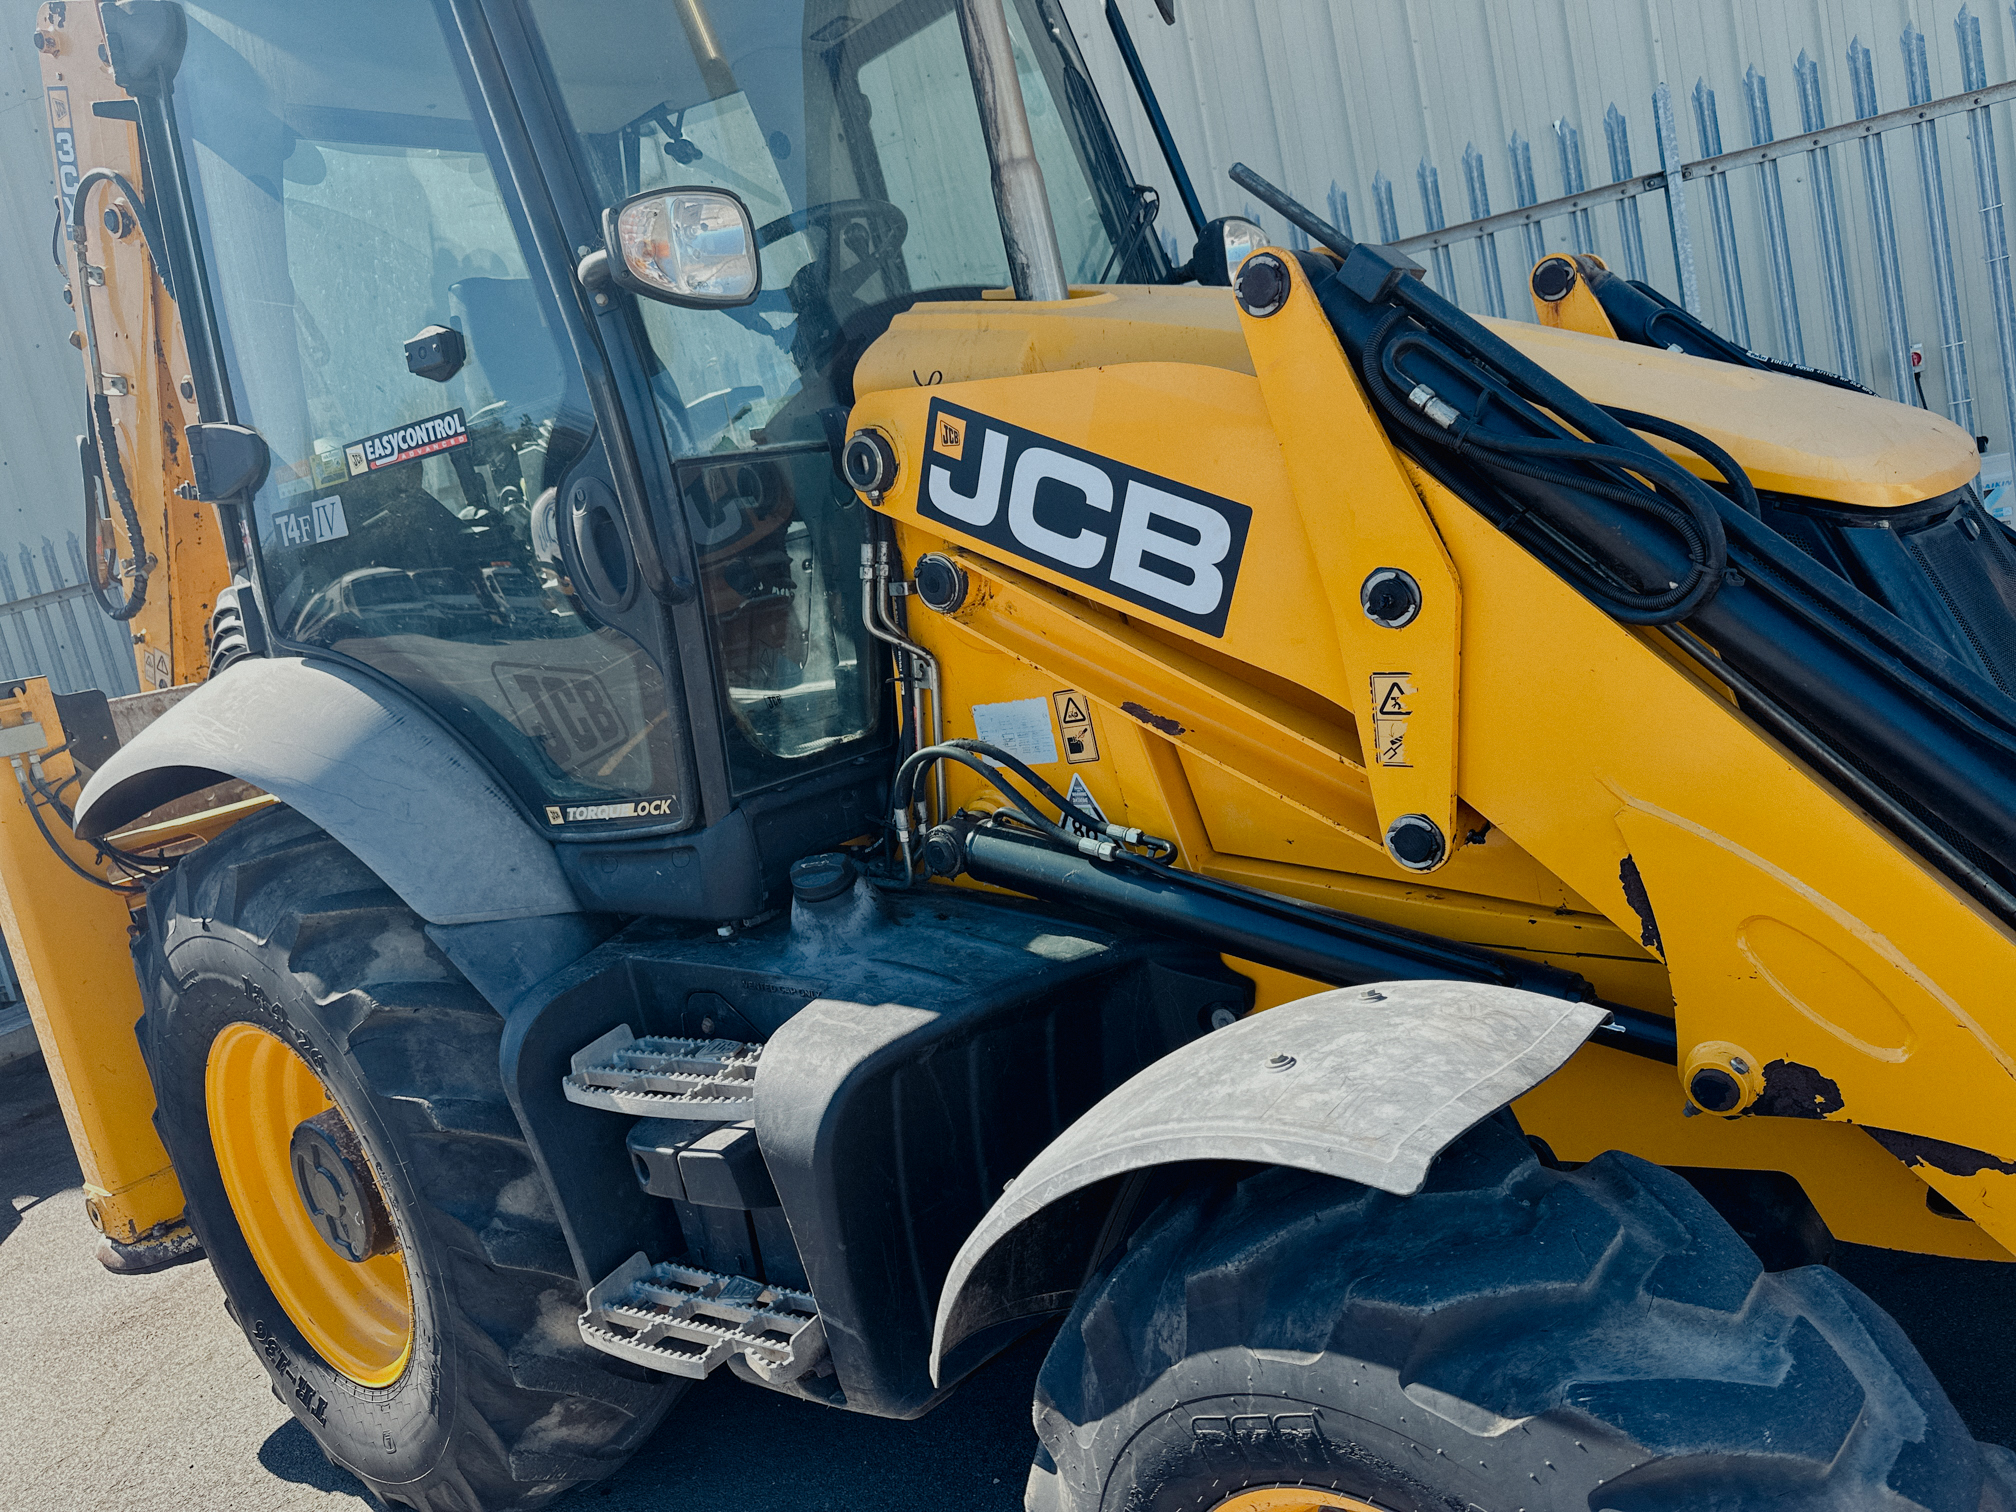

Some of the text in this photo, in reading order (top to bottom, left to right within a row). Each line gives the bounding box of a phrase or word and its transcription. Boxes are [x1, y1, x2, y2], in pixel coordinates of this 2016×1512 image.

[1770, 358, 1794, 368] TOUGH
[1796, 364, 1815, 373] COVER
[364, 413, 466, 466] EASYCONTROL
[400, 436, 466, 460] ADVANCED
[941, 423, 961, 445] JCB
[1983, 480, 2012, 489] AIKIN
[315, 502, 336, 538] IV
[928, 428, 1231, 614] JCB
[513, 674, 620, 766] JCB
[253, 1320, 329, 1428] TR-136
